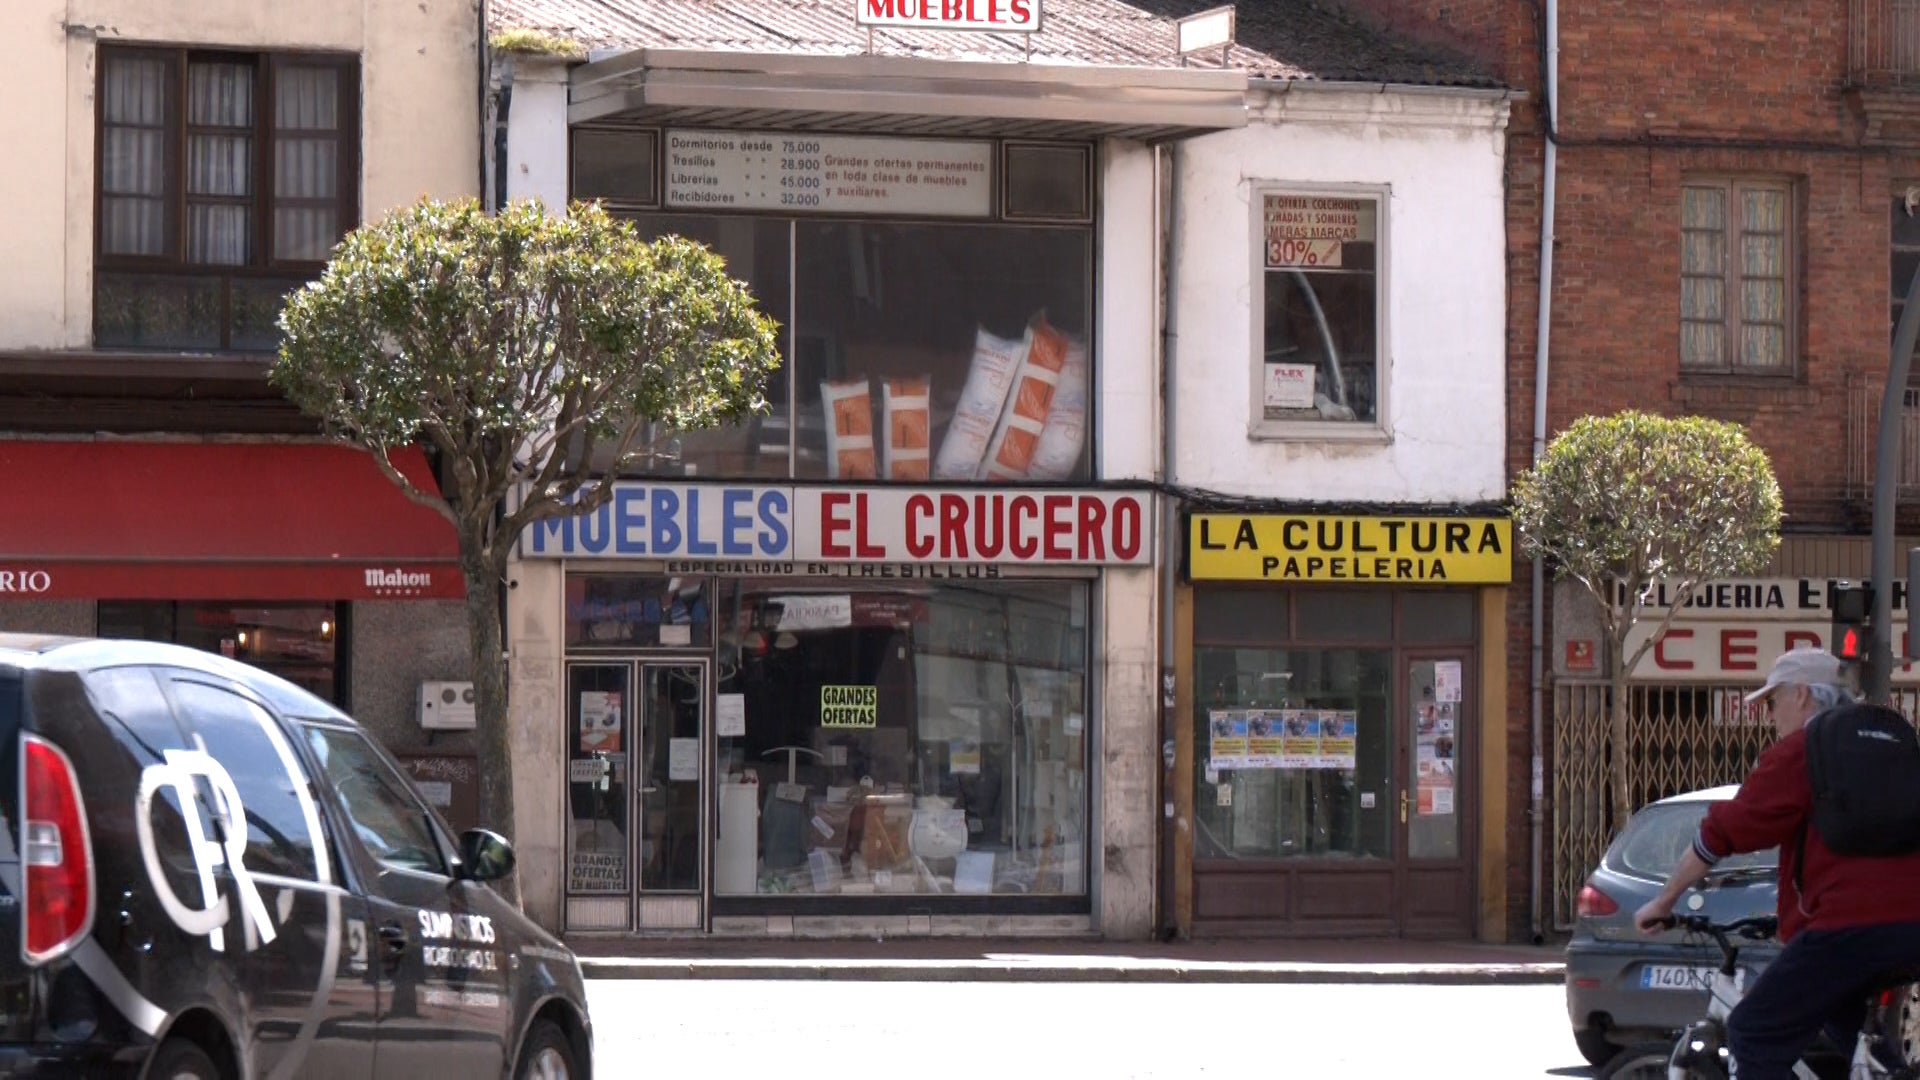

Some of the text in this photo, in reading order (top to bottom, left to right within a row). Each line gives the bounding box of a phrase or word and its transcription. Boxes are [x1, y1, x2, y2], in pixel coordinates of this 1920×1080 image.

[866, 0, 1031, 24] MUEBLES
[670, 137, 821, 154] Dormitorios desde 75.000
[672, 154, 821, 171] Tresillos 28.900
[824, 154, 985, 173] Grandes ofertas permanentes
[670, 173, 719, 186] Librerias
[825, 170, 968, 187] en toda clase de muebles
[670, 189, 821, 206] Recibidores 32.000
[825, 187, 832, 198] y
[1278, 197, 1308, 210] OFERTA
[1312, 197, 1361, 211] COLCHONES
[1307, 213, 1313, 224] Y
[1315, 213, 1358, 226] SOMIERES
[1311, 227, 1358, 240] MARCAS
[1269, 240, 1318, 265] 30%
[532, 486, 1142, 561] MUEBLES EL CRUCERO
[1200, 518, 1503, 554] LA CULTURA
[668, 562, 999, 578] ESPECIALIDAD EN TRESILLOS
[1262, 556, 1448, 579] PAPELERIA
[0, 570, 51, 592] RIO
[365, 568, 431, 586] Mahou
[823, 687, 876, 706] GRANDES
[823, 707, 876, 724] OFERTAS
[573, 855, 624, 866] GRANDES
[572, 867, 622, 880] OFERTAS
